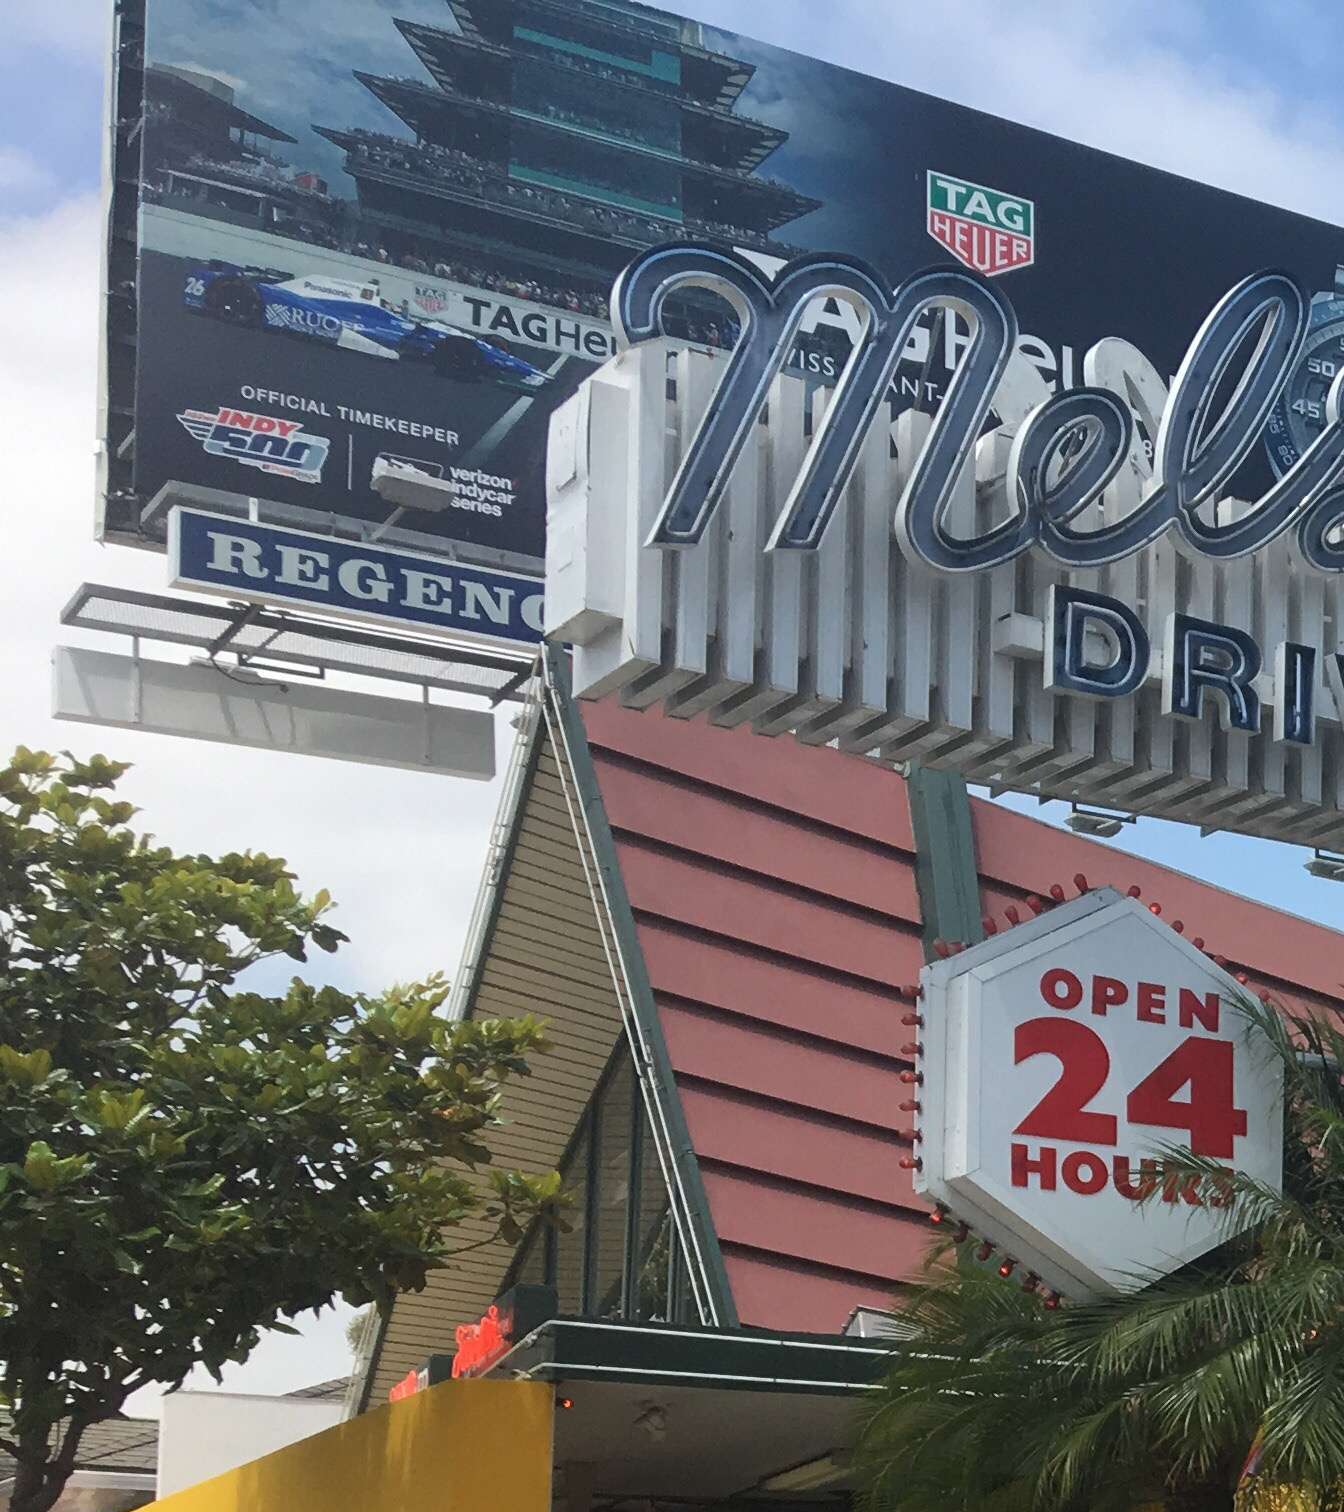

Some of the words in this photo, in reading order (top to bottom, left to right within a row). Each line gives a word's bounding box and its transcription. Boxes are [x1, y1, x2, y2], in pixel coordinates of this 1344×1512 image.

[936, 179, 1024, 232] TAG
[933, 214, 1028, 271] HEUER
[1308, 359, 1335, 378] 50
[217, 409, 299, 437] INDY
[240, 385, 331, 418] OFFICIAL
[336, 405, 461, 447] TIMEKEEPER
[1292, 398, 1320, 419] 45
[208, 425, 324, 469] 500
[449, 465, 512, 491] verizon
[450, 478, 516, 505] indycar
[450, 496, 502, 517] series
[1040, 967, 1220, 1033] OPEN
[1012, 1016, 1248, 1159] 24
